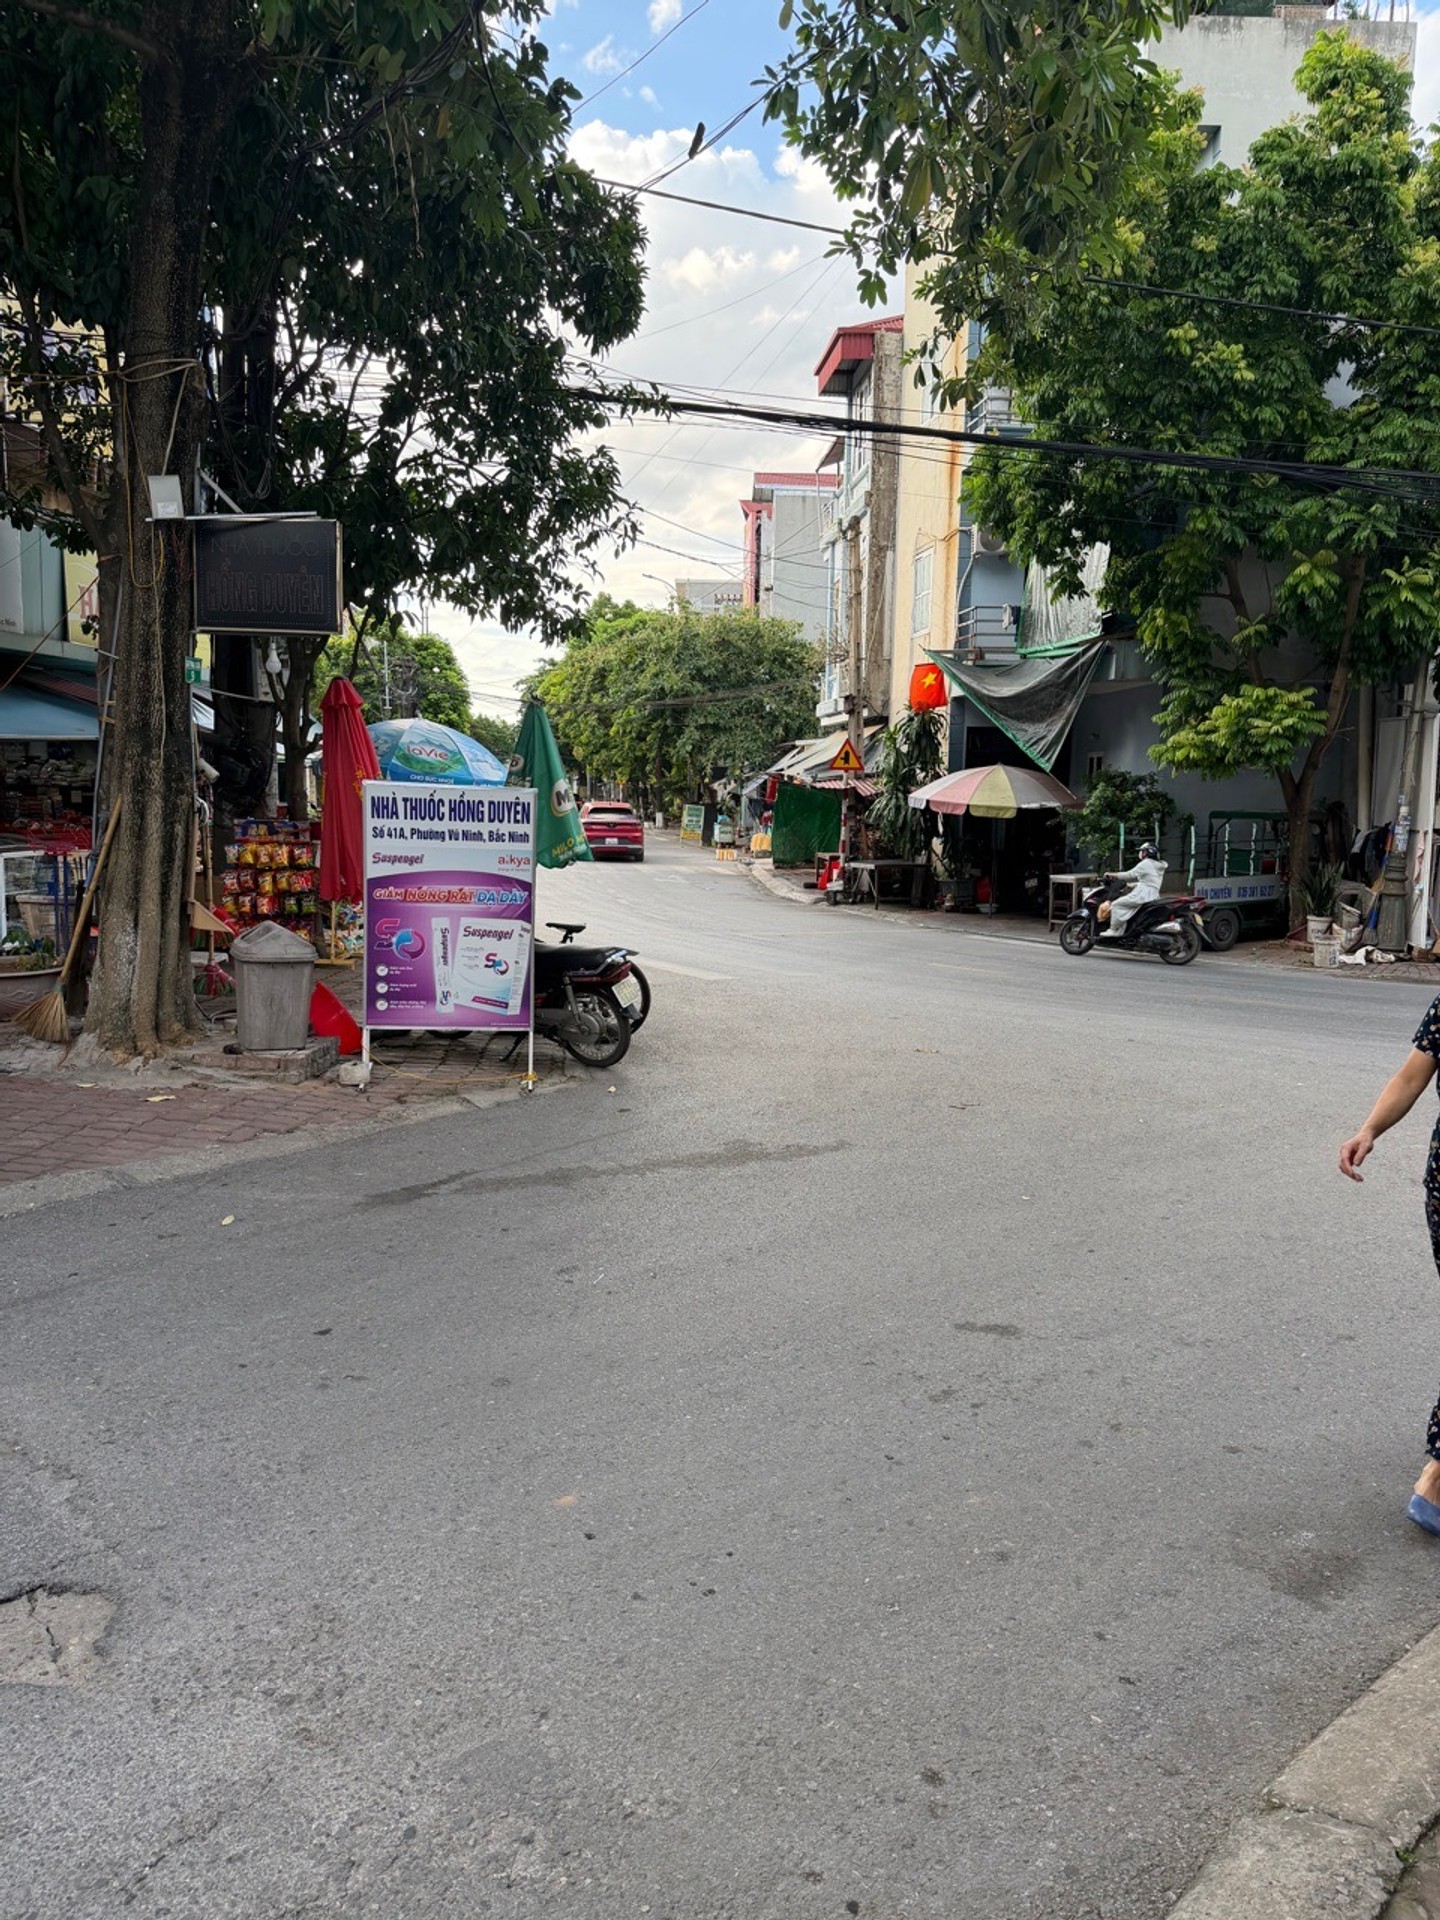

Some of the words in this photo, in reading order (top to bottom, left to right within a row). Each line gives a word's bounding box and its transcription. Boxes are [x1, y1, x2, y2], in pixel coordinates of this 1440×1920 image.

[211, 535, 250, 554] NHÀ
[206, 557, 258, 613] HỒNG
[262, 565, 325, 615] DUYÊN
[371, 791, 399, 819] NHÀ
[402, 790, 445, 822] THUỐC
[449, 791, 485, 823] HỒNG
[487, 797, 531, 825] DUYÊN
[372, 825, 385, 839] Số
[387, 827, 408, 840] 41A,
[410, 828, 446, 843] Phường
[462, 829, 486, 843] Ninh,
[488, 828, 506, 842] Bắc
[508, 831, 530, 843] Ninh
[372, 852, 424, 866] Suspengel
[406, 886, 449, 902] NÓNG
[449, 887, 476, 902] RÁT
[475, 889, 498, 906] DẠ
[463, 925, 514, 941] Suspengel
